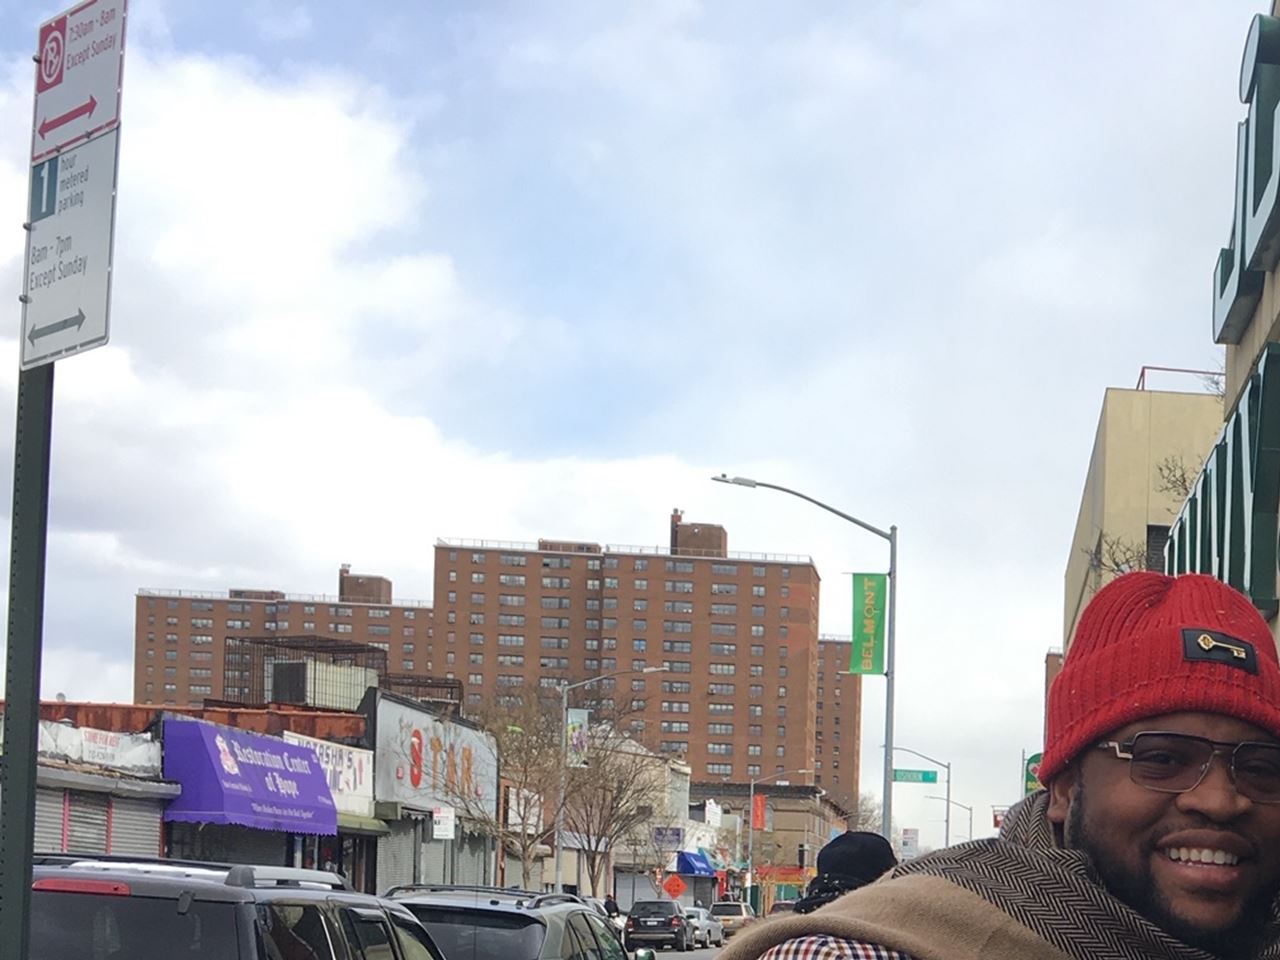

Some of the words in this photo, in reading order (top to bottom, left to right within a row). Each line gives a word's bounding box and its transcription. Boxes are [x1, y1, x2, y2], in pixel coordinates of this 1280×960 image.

[66, 44, 90, 71] Except
[91, 31, 117, 58] Sunday
[40, 160, 50, 213] 1
[57, 190, 85, 216] parking
[30, 264, 57, 291] Except
[58, 256, 88, 280] Sunday
[861, 577, 877, 671] BELMONT
[230, 740, 285, 770] Restoration
[283, 752, 312, 775] Center
[264, 772, 277, 793] of
